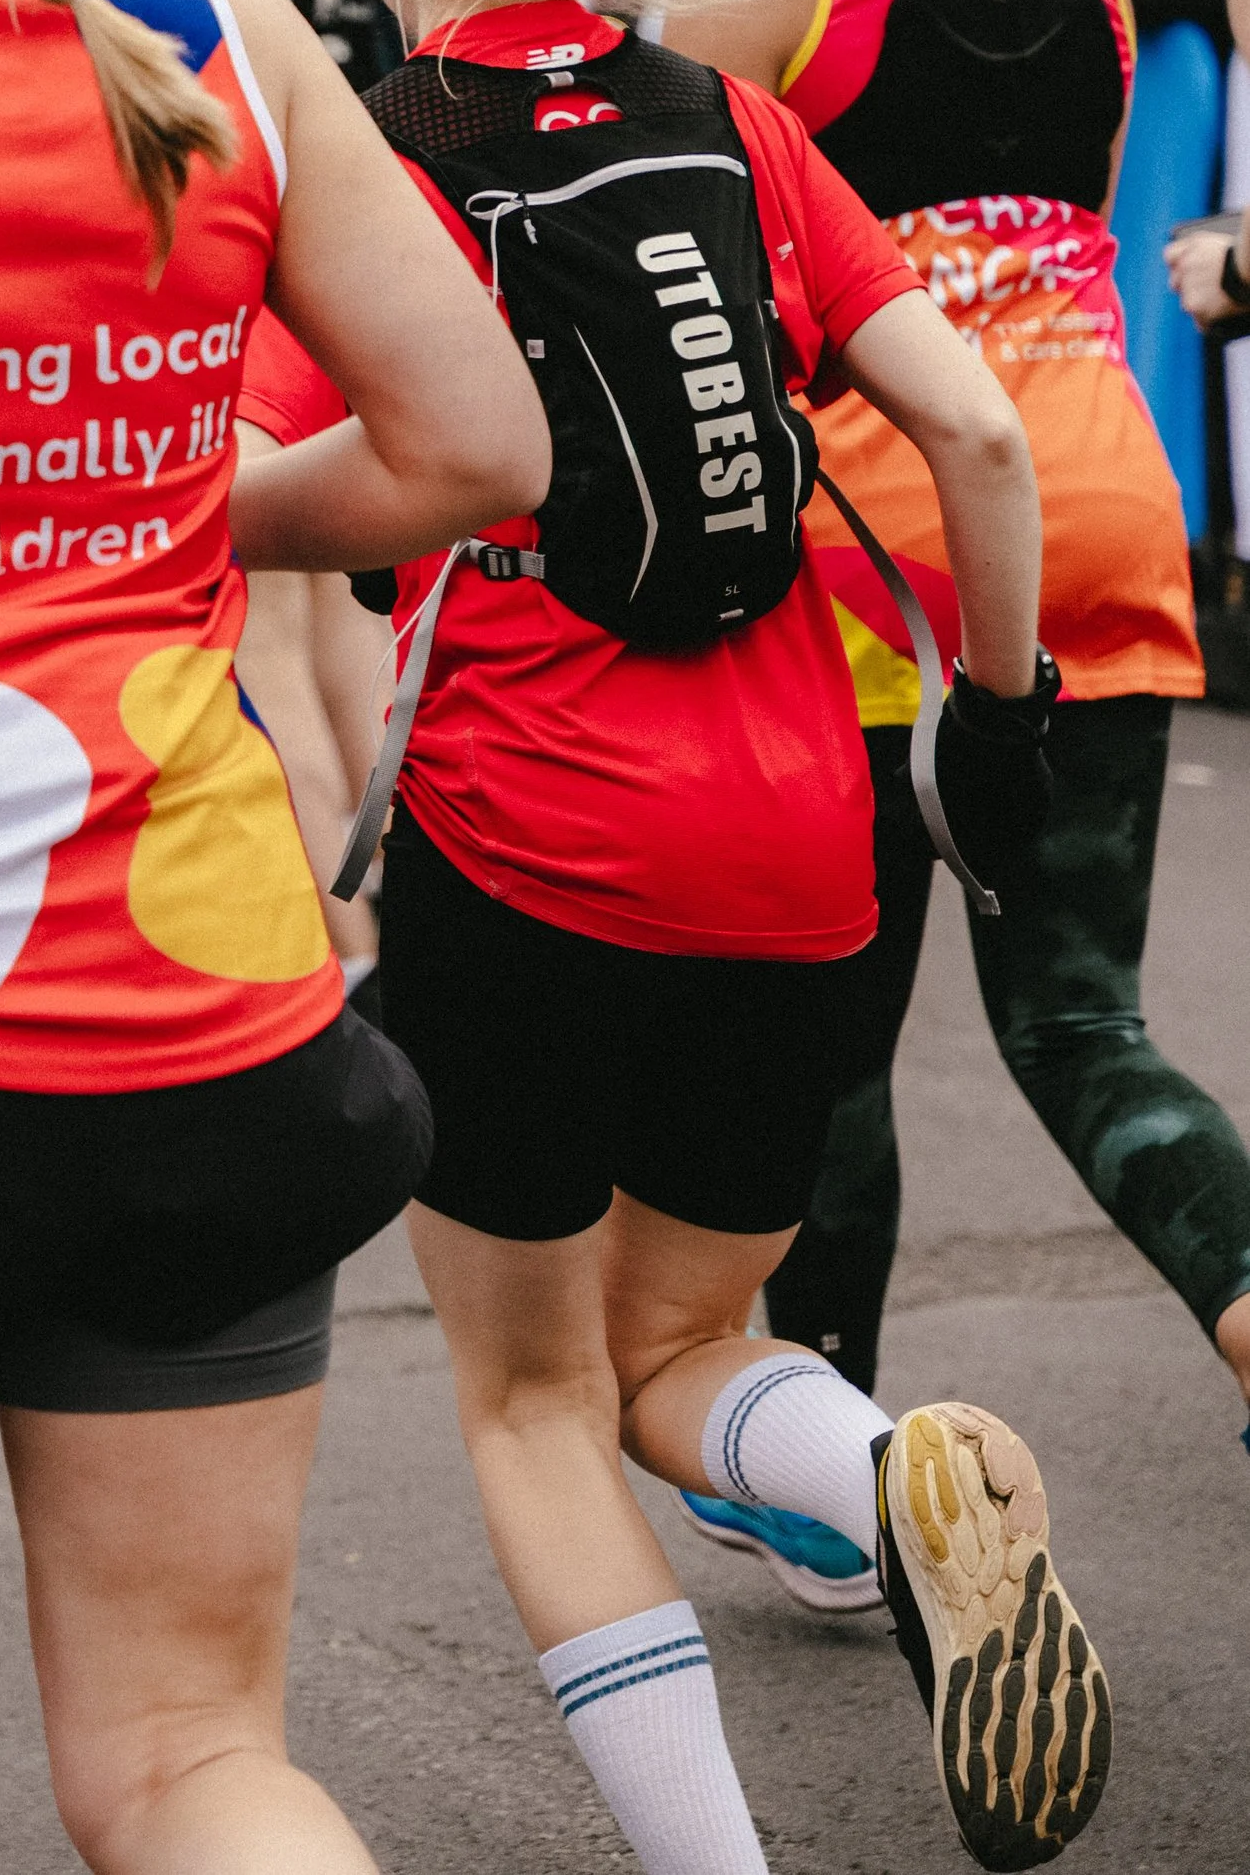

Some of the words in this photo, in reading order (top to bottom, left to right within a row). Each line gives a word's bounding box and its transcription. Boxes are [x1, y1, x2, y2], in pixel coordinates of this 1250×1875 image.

[95, 305, 248, 384] local
[636, 231, 767, 534] UTOBEST
[185, 396, 230, 462] ill
[724, 584, 741, 597] 5L
